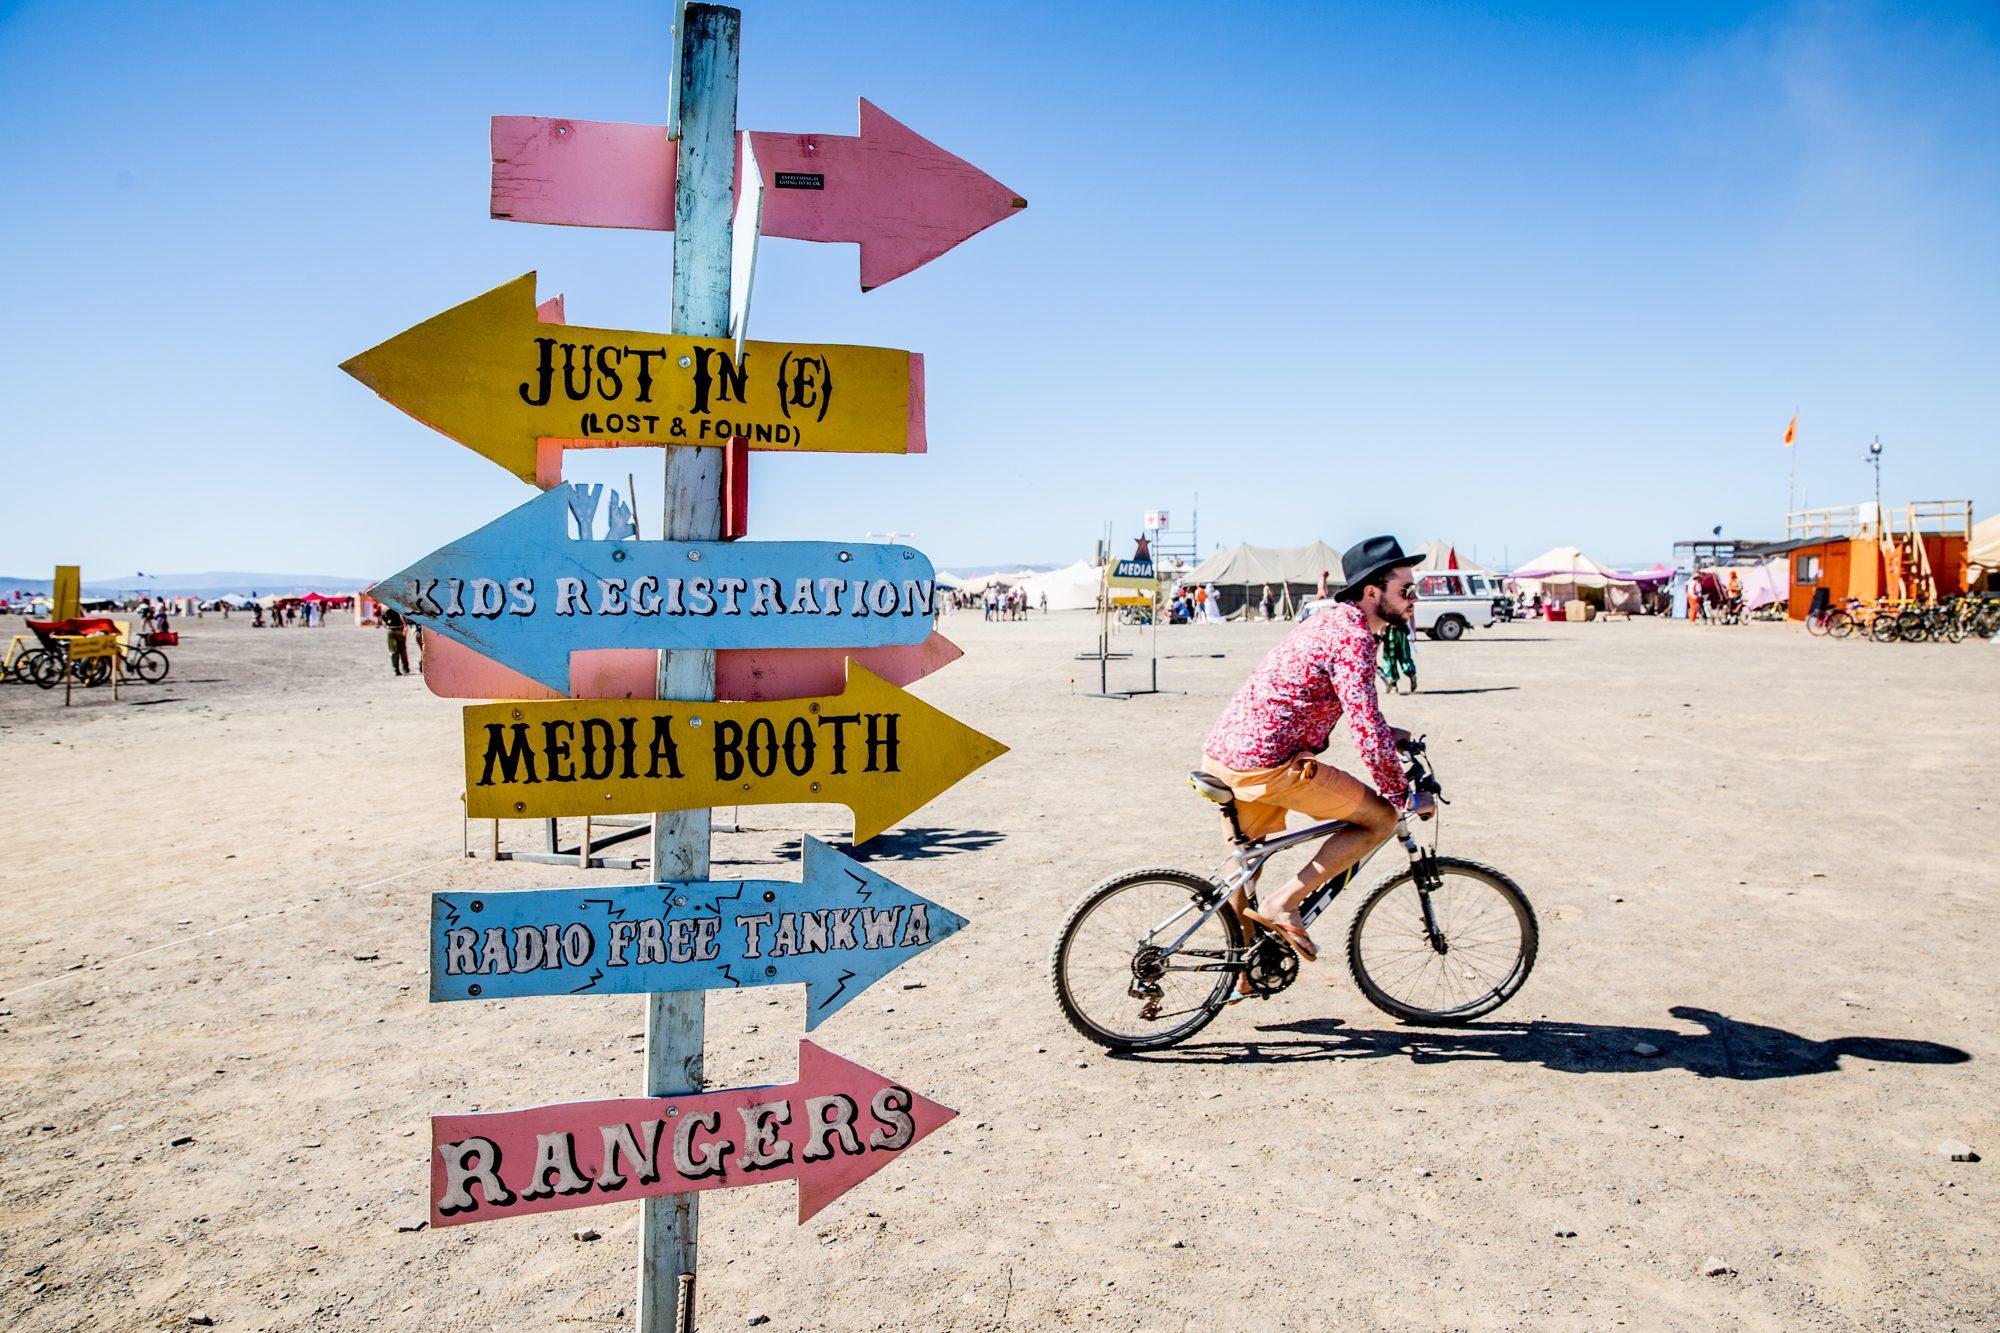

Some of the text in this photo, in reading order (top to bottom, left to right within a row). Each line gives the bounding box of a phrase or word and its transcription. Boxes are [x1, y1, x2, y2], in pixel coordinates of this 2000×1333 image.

[519, 337, 832, 423] JUST IN (E)
[581, 412, 801, 447] (LOST & FOUND)
[404, 575, 935, 620] KIDS REGISTRATION
[1118, 562, 1152, 577] MEDIA
[476, 712, 902, 786] MEDIA BOOTH
[445, 903, 932, 976] RADIO FREE TANKWA
[437, 1085, 916, 1217] RANGERS
